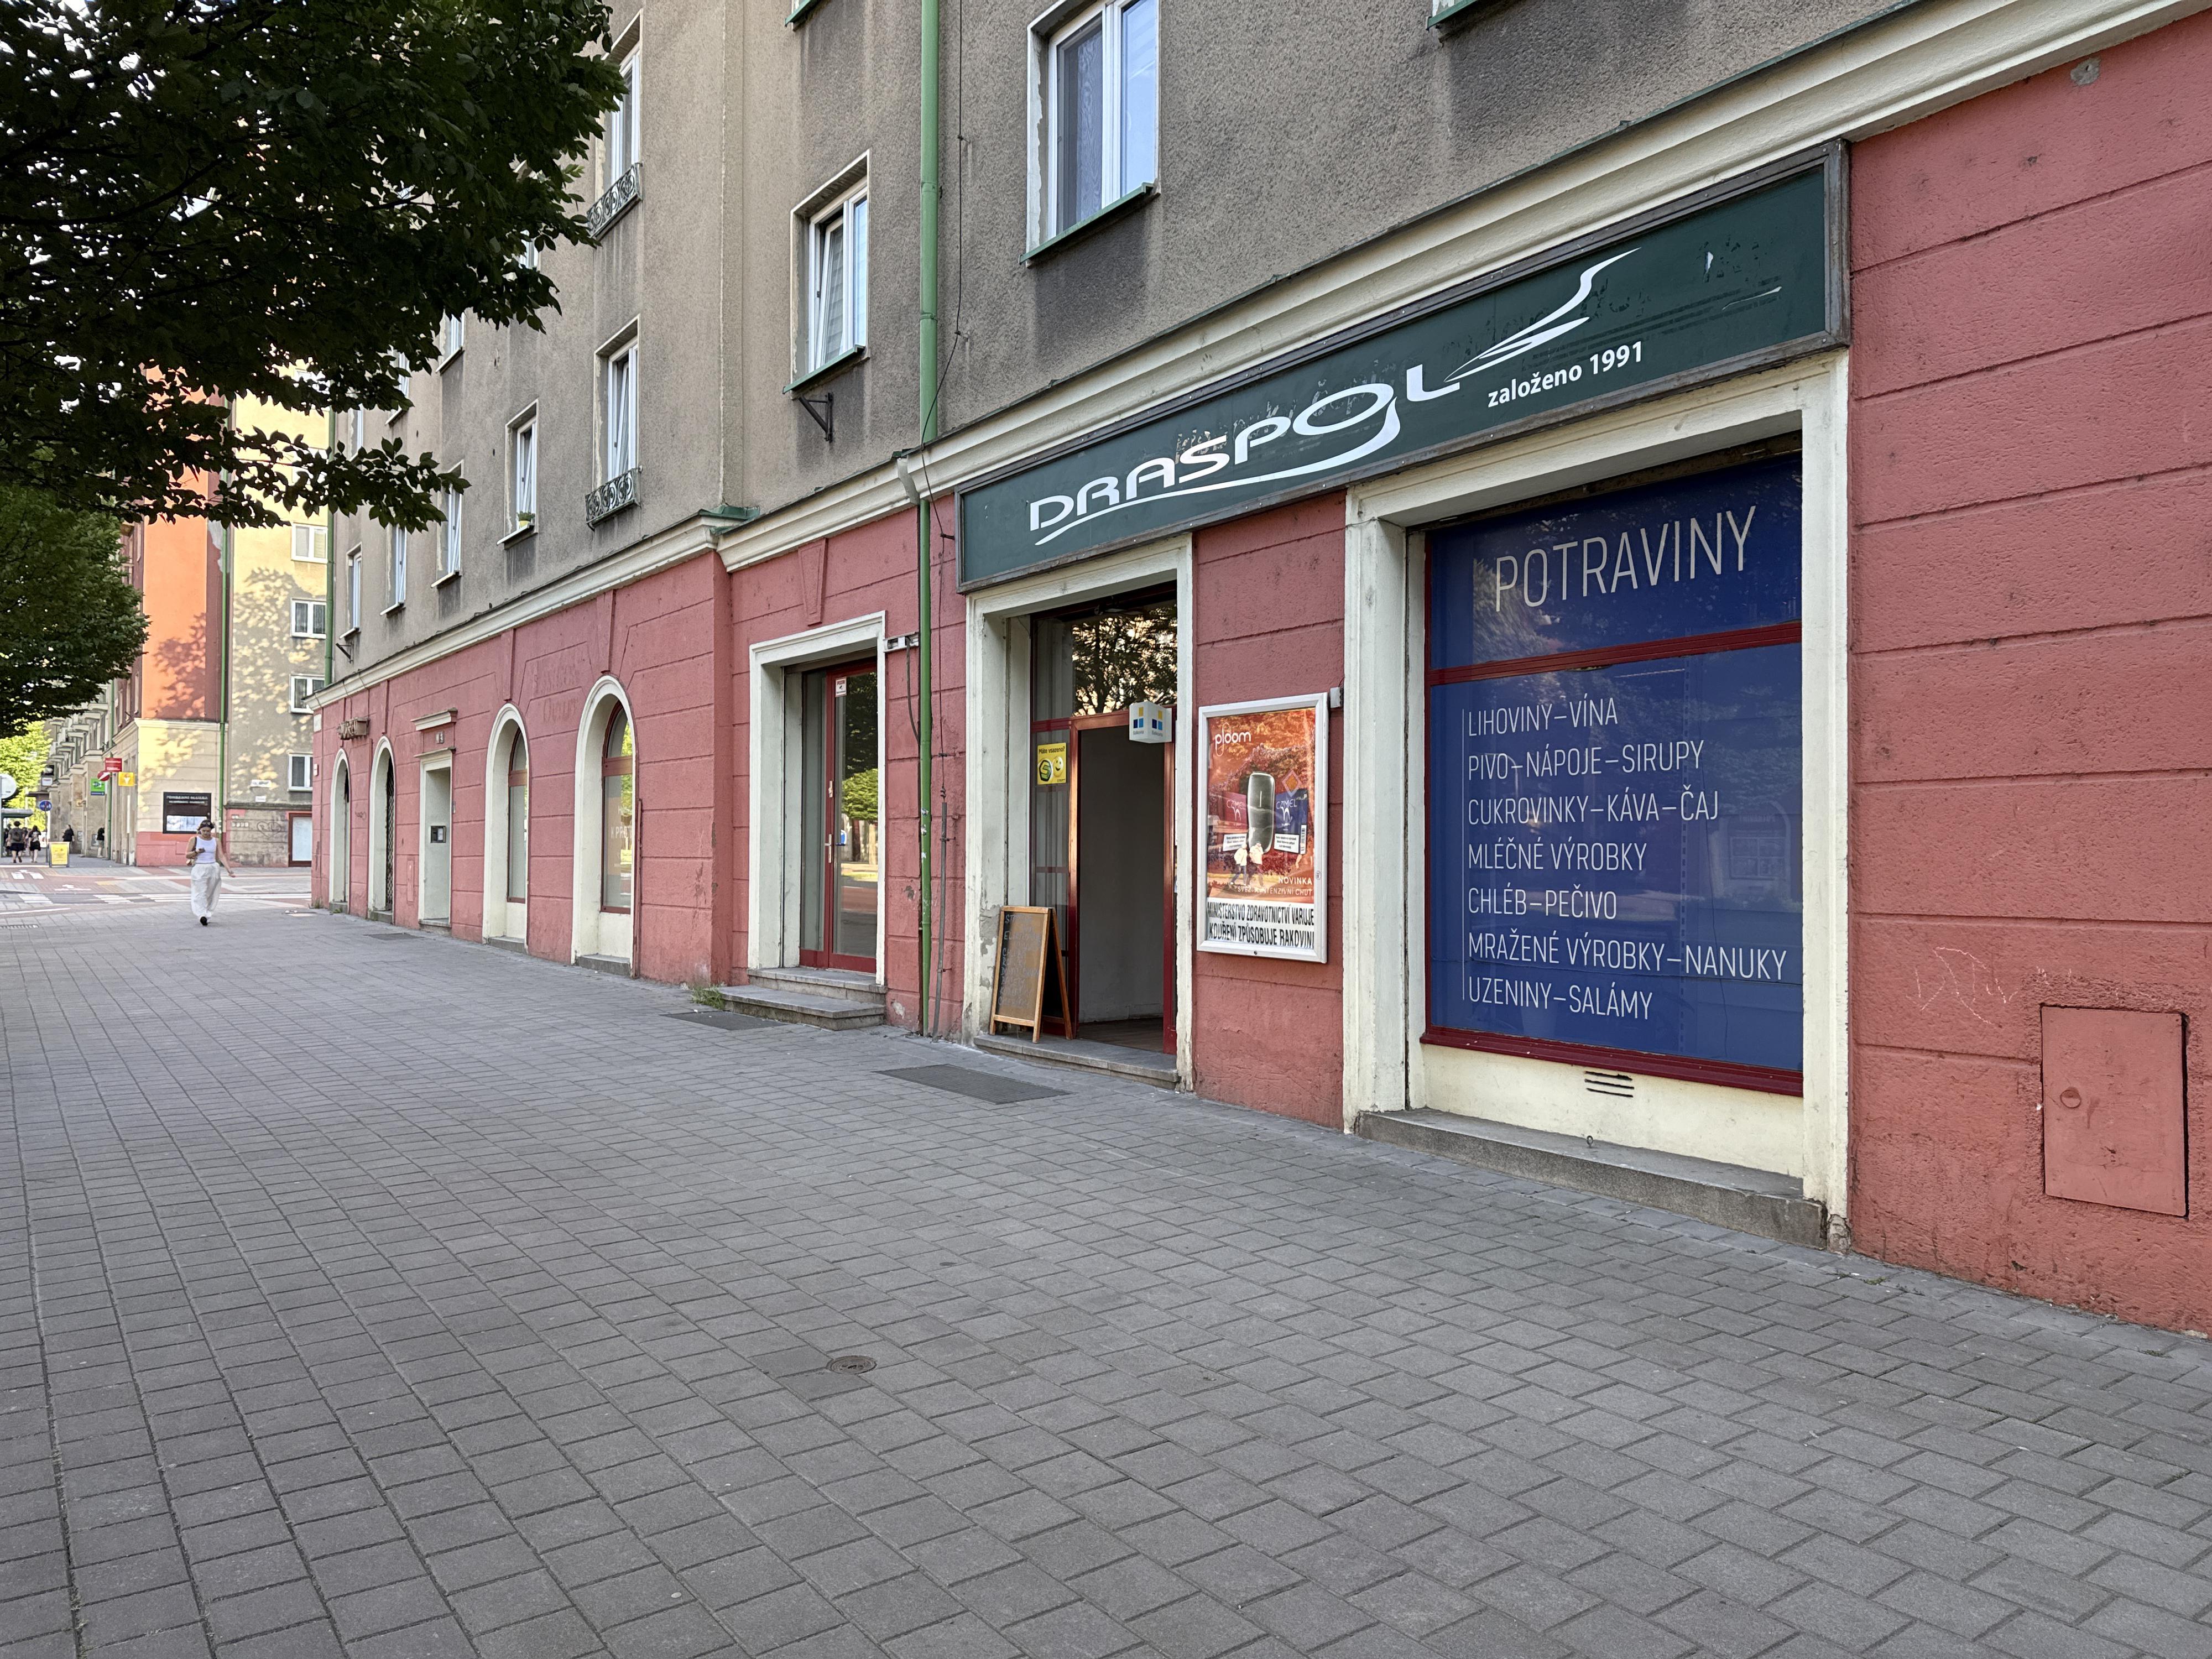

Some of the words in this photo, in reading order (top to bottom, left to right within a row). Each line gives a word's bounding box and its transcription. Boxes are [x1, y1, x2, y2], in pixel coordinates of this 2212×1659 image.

[1488, 364, 1583, 409] založeno
[1590, 341, 1644, 375] 1991
[1029, 363, 1460, 531] DRASPOL
[1495, 505, 1756, 612] POTRAVINY
[1215, 722, 1251, 757] ploom
[1276, 799, 1298, 810] CAMEL
[1469, 836, 1543, 870] MLÉČNÉ
[1551, 836, 1647, 870] VÝROBKY
[1278, 876, 1313, 885] NOVINKA
[1207, 901, 1245, 921] MINISTERSTVO
[1246, 904, 1291, 924] ZDRAVOTNICTVÍ
[1292, 907, 1314, 926] VARUJE
[1209, 921, 1237, 941] KOUŘENÍ
[1238, 922, 1277, 946] ZPŮSOBUJE
[1469, 927, 1559, 964] MRAŽENÉ
